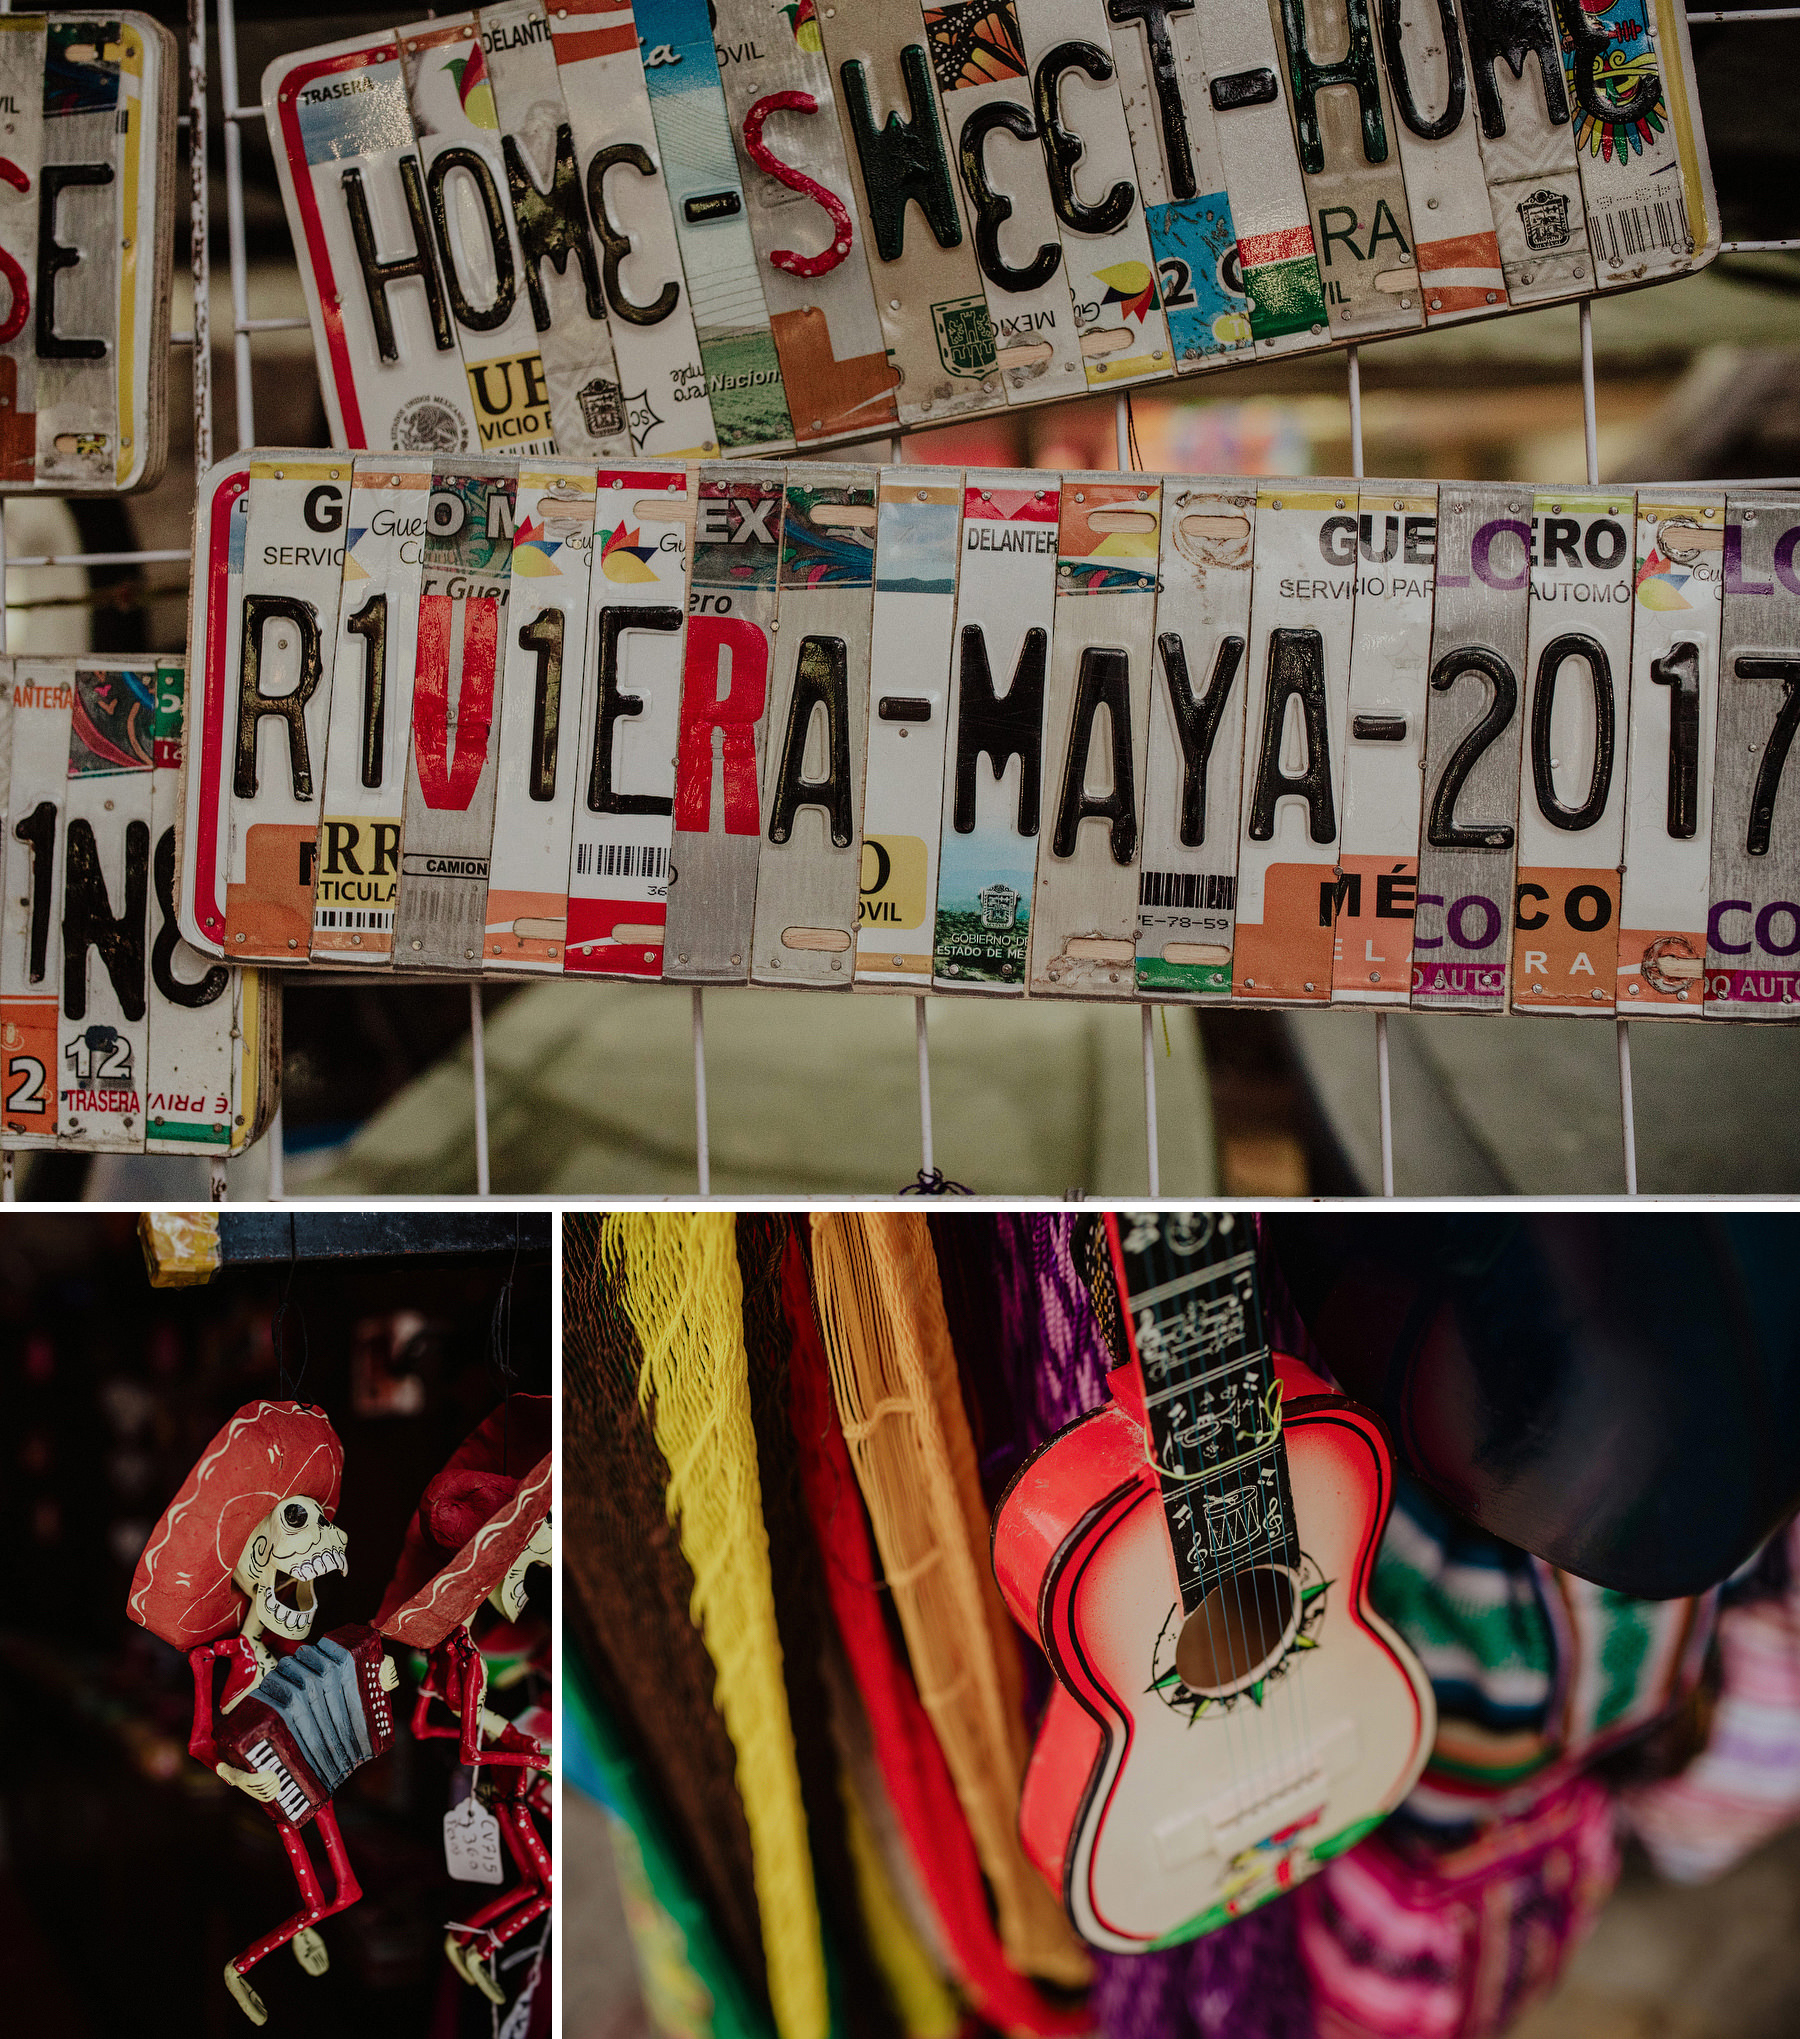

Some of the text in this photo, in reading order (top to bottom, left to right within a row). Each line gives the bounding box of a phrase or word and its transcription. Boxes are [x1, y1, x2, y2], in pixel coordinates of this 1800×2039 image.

[301, 76, 374, 106] TRASERA
[304, 485, 343, 533] G
[426, 859, 488, 876] CAMION
[951, 932, 1012, 948] GOBIERNO
[936, 945, 982, 957] ESTADO
[986, 948, 1003, 958] DE
[67, 1089, 141, 1113] TRASERA
